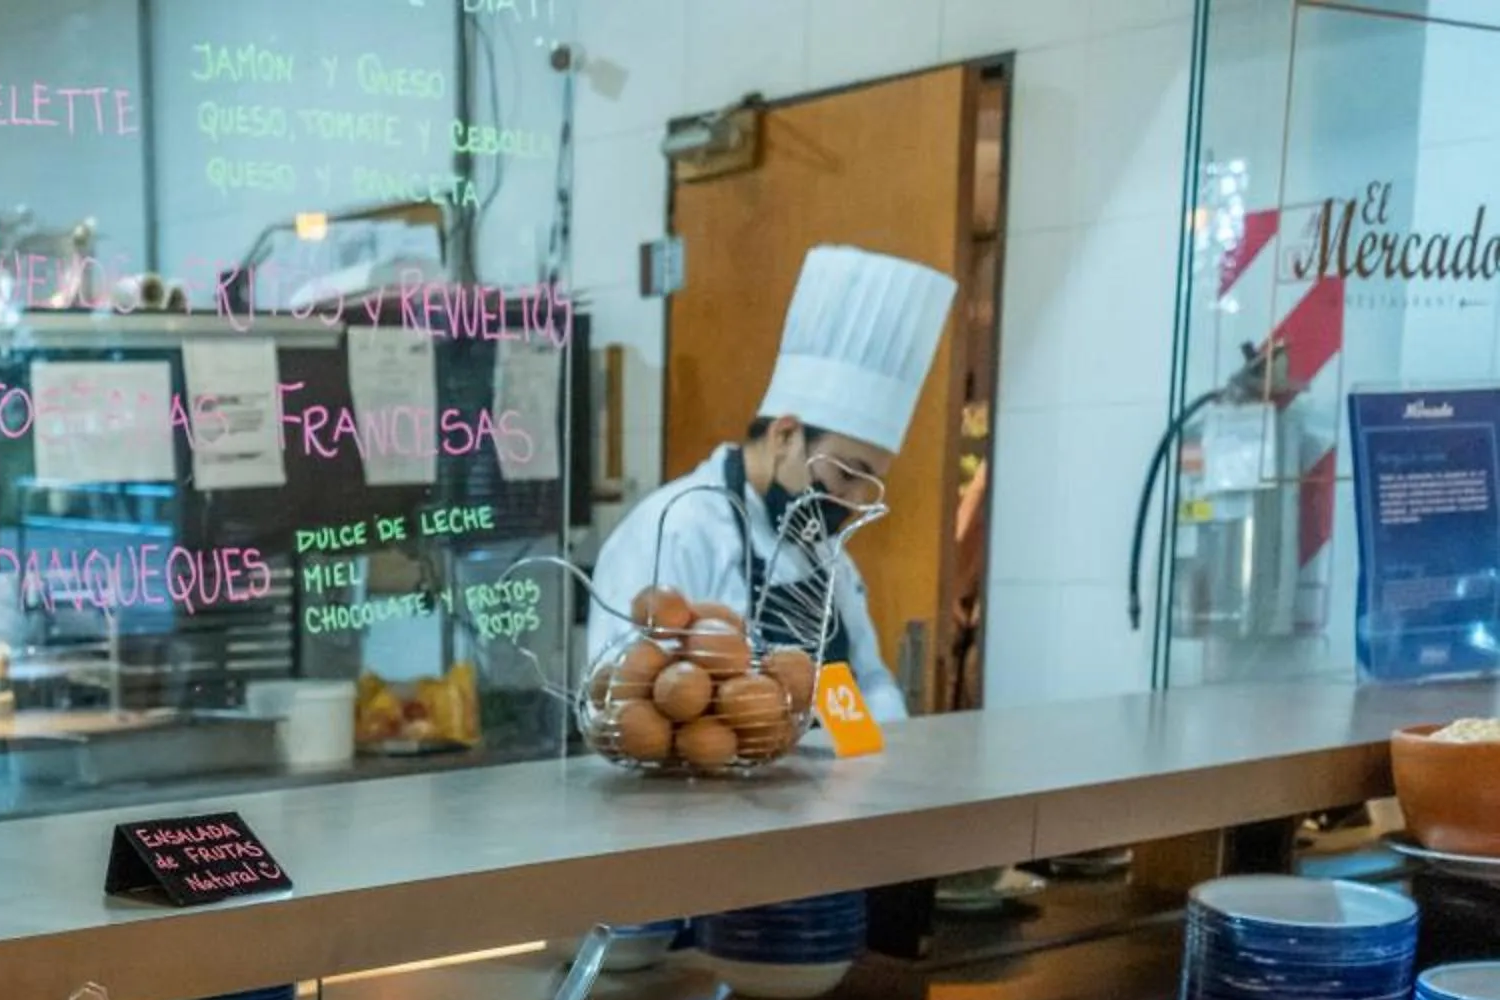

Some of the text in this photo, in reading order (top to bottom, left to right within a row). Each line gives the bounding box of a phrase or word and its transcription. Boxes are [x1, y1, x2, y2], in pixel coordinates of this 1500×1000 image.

[1361, 179, 1393, 226] El
[274, 381, 534, 463] FRANCESAS
[295, 505, 496, 553] DULCE DE LECHE
[302, 561, 362, 595] MIEL
[304, 592, 431, 634] CHOCOLATE
[135, 823, 241, 849] ENSALADA
[182, 841, 264, 865] FRUTAS
